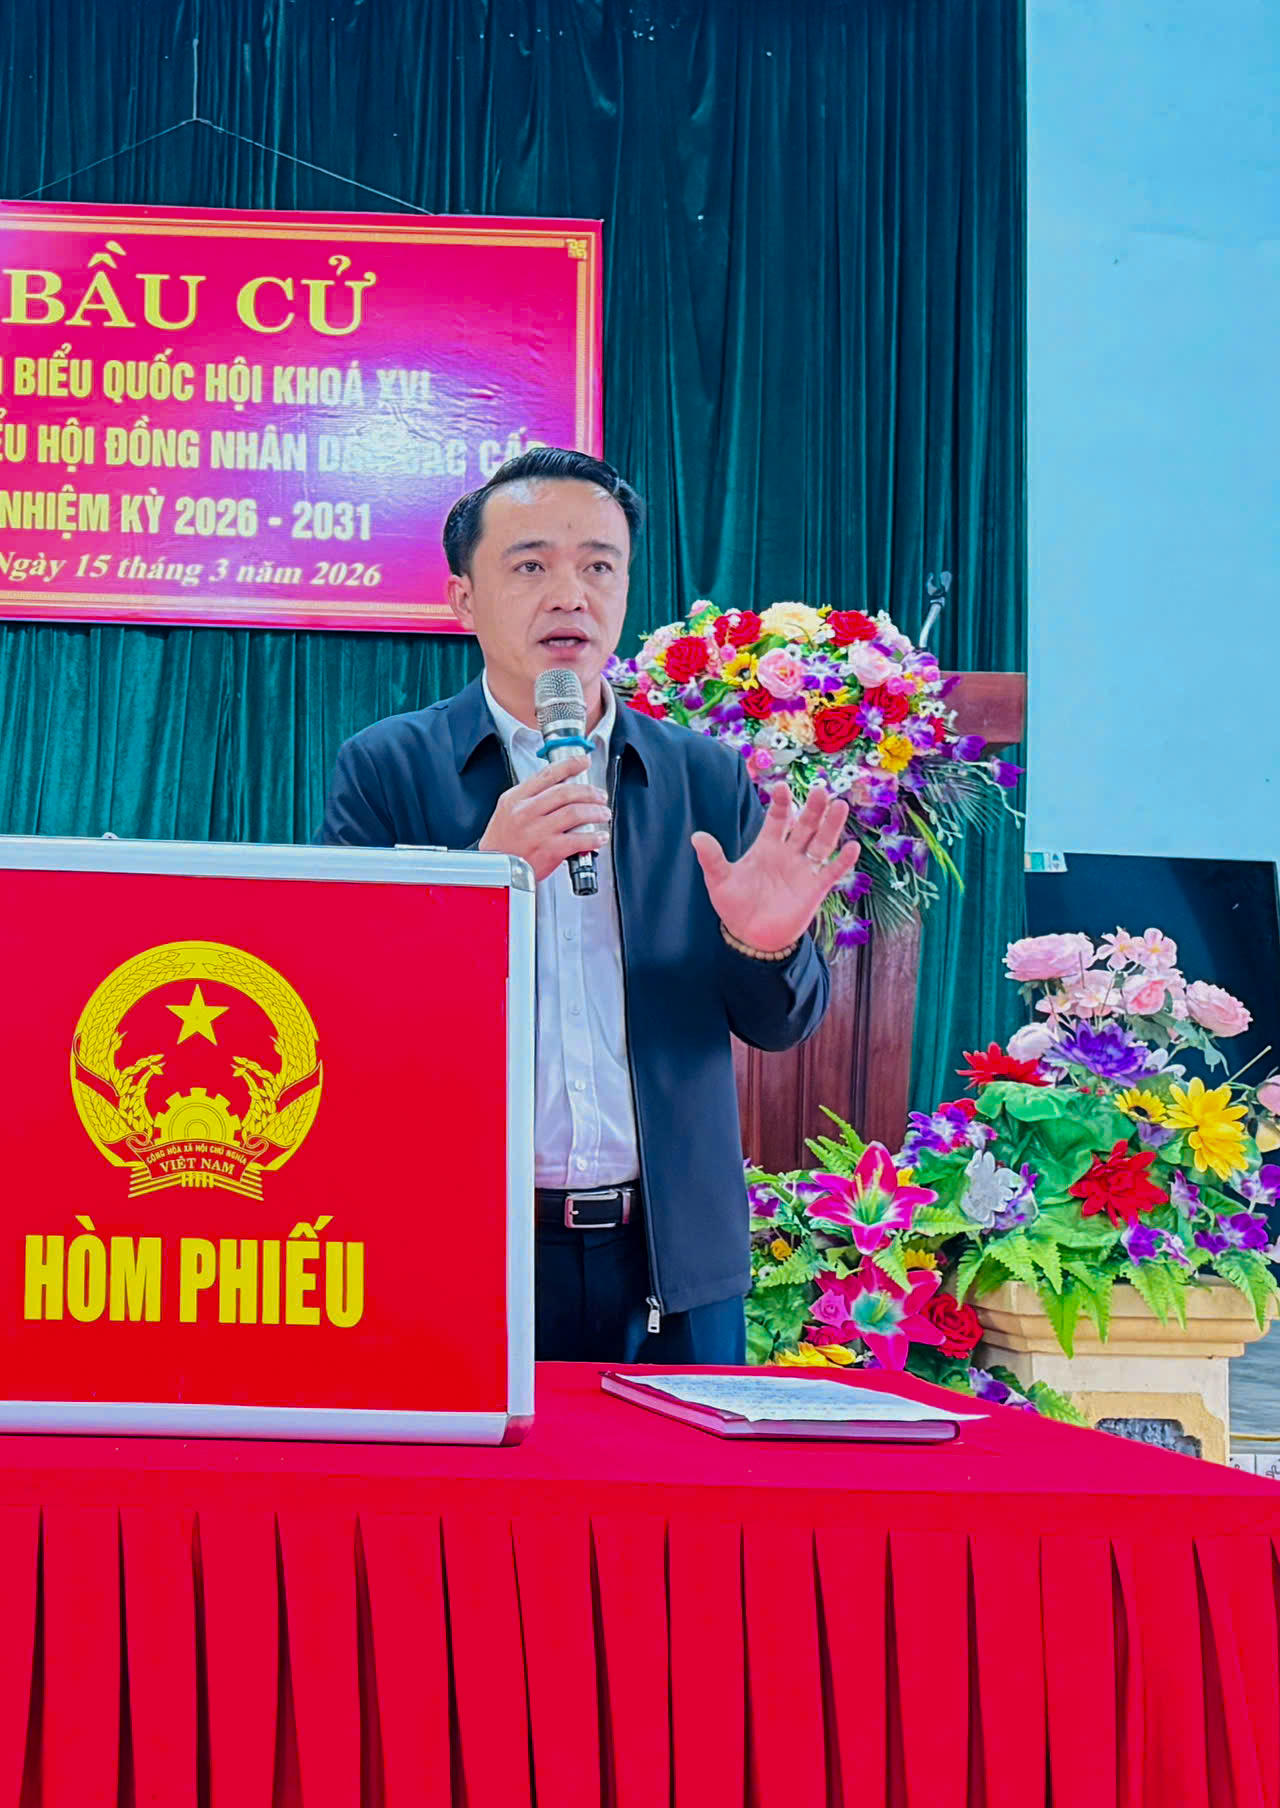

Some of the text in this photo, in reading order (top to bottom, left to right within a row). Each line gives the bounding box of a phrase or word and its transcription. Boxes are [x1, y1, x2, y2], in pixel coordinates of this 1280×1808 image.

[2, 240, 377, 335] BẦU CỬ
[14, 342, 93, 398] BIỂU
[103, 348, 195, 404] QUỐC
[205, 356, 262, 411] HỘI
[273, 360, 363, 407] KHOÁ
[38, 417, 94, 472] HỘI
[105, 415, 200, 468] ĐỒNG
[210, 424, 307, 472] NHÂN
[479, 427, 549, 478] CẤ
[121, 487, 165, 534] KỲ
[174, 496, 258, 537] 2026
[268, 516, 282, 526] -
[291, 501, 370, 541] 2031
[75, 554, 112, 578] 15
[117, 555, 204, 588] tháng
[208, 558, 229, 582] 3
[236, 561, 303, 585] năm
[310, 561, 384, 587] 2026
[200, 1157, 236, 1175] NAM
[24, 1215, 365, 1328] HÒM PHIẾU
